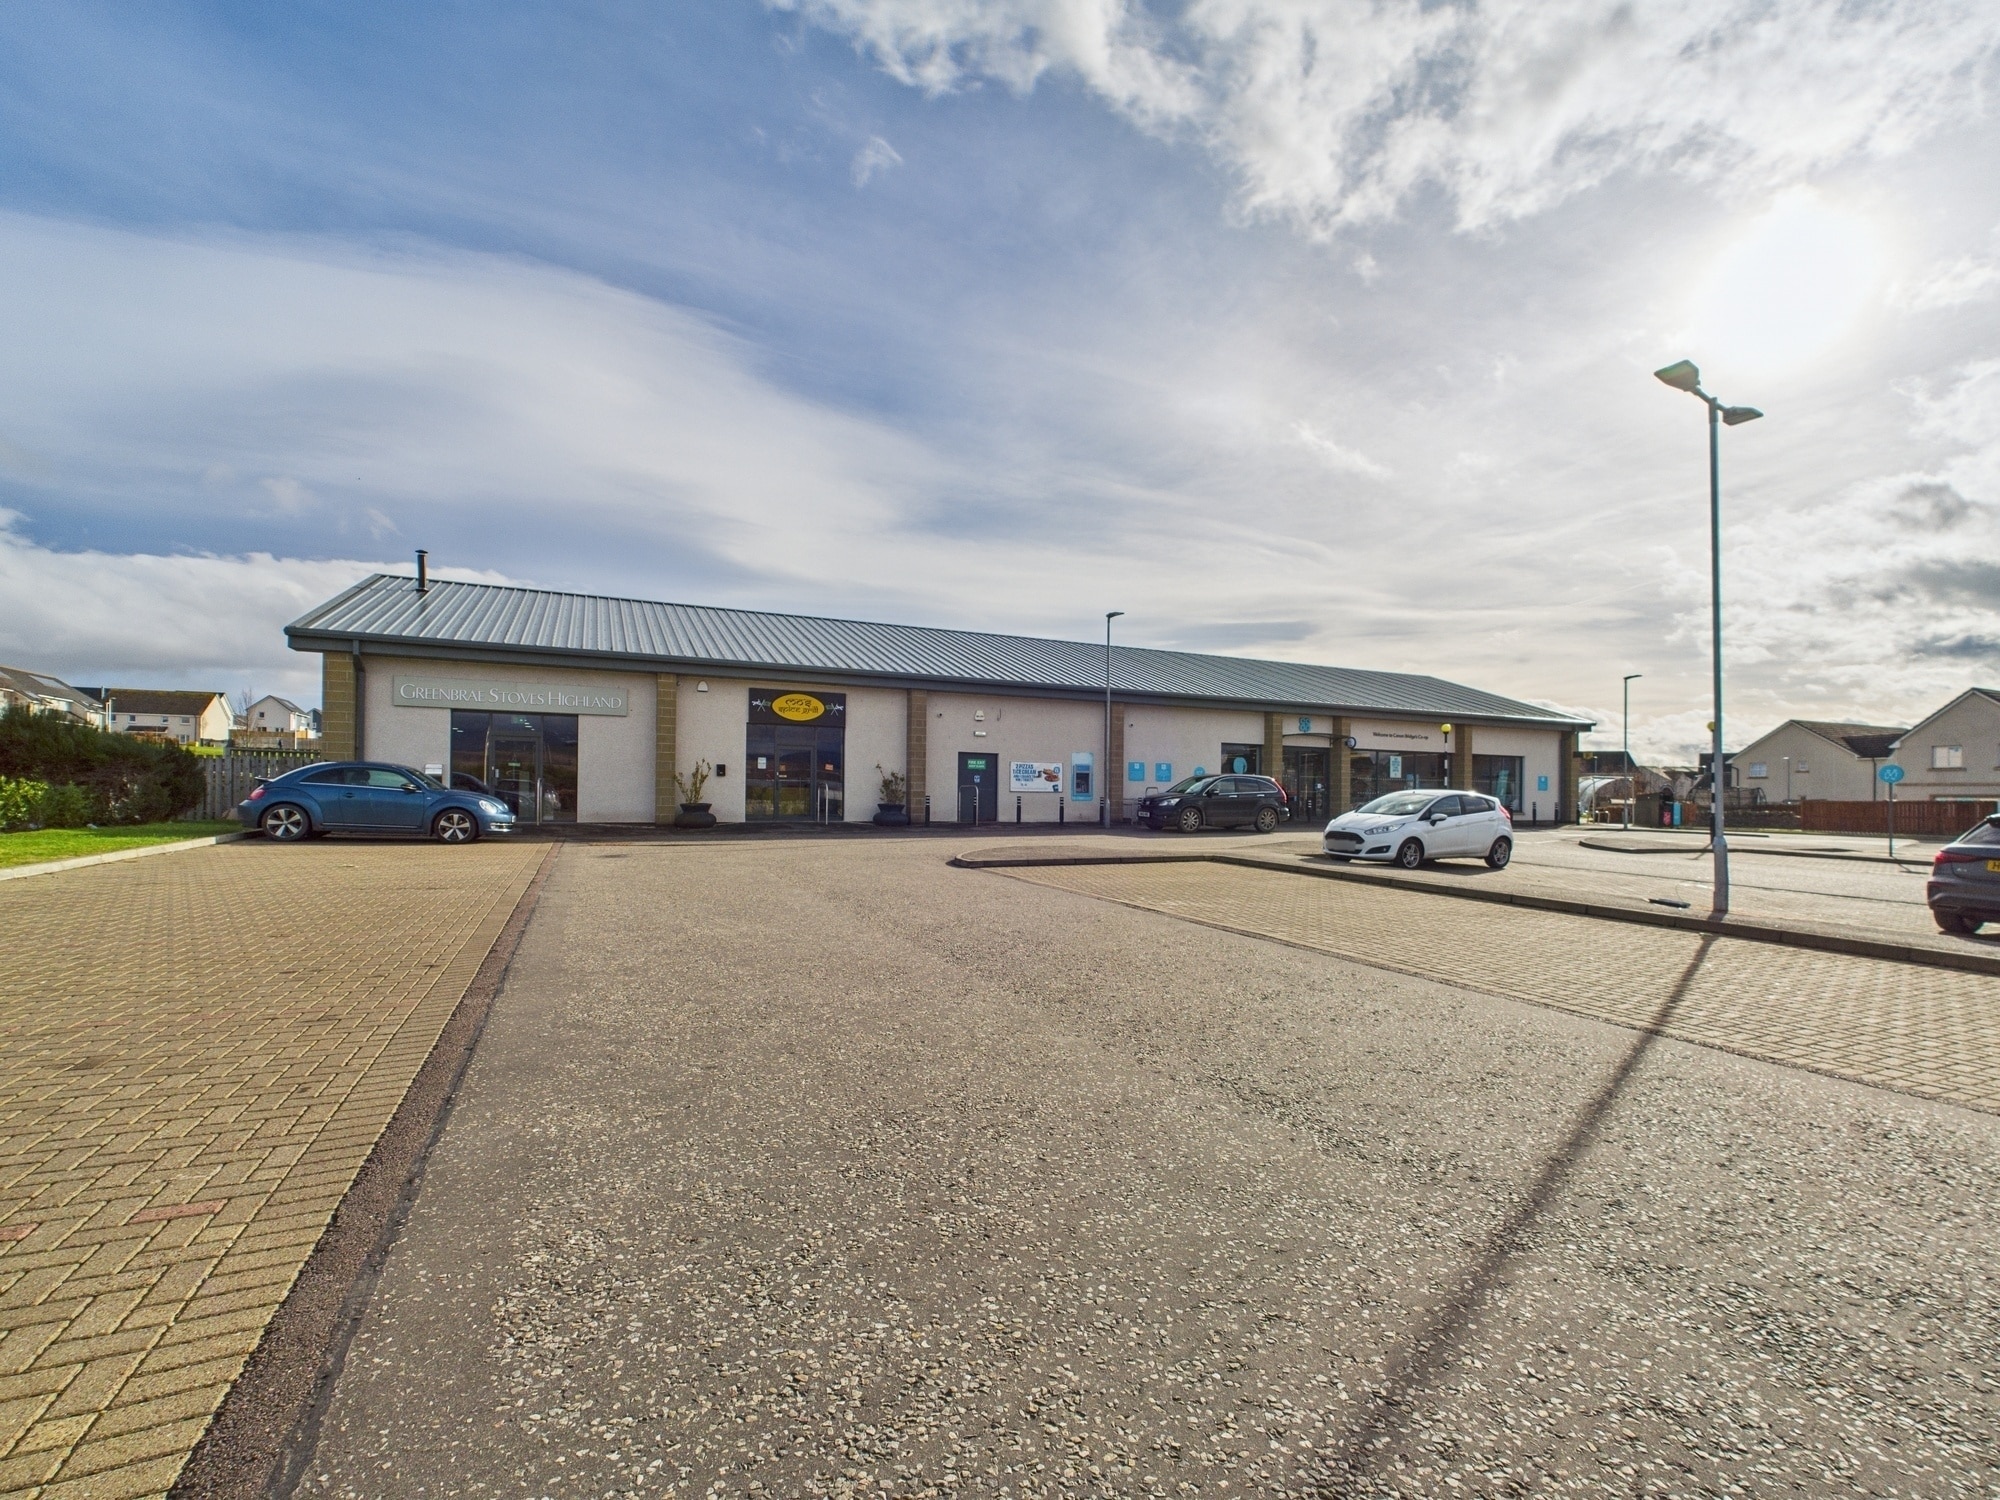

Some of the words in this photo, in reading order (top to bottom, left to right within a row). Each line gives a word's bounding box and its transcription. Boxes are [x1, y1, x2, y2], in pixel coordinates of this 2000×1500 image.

[400, 683, 484, 702] GREENBRAE
[488, 688, 545, 705] STOVES
[548, 691, 622, 709] HIGHLAND
